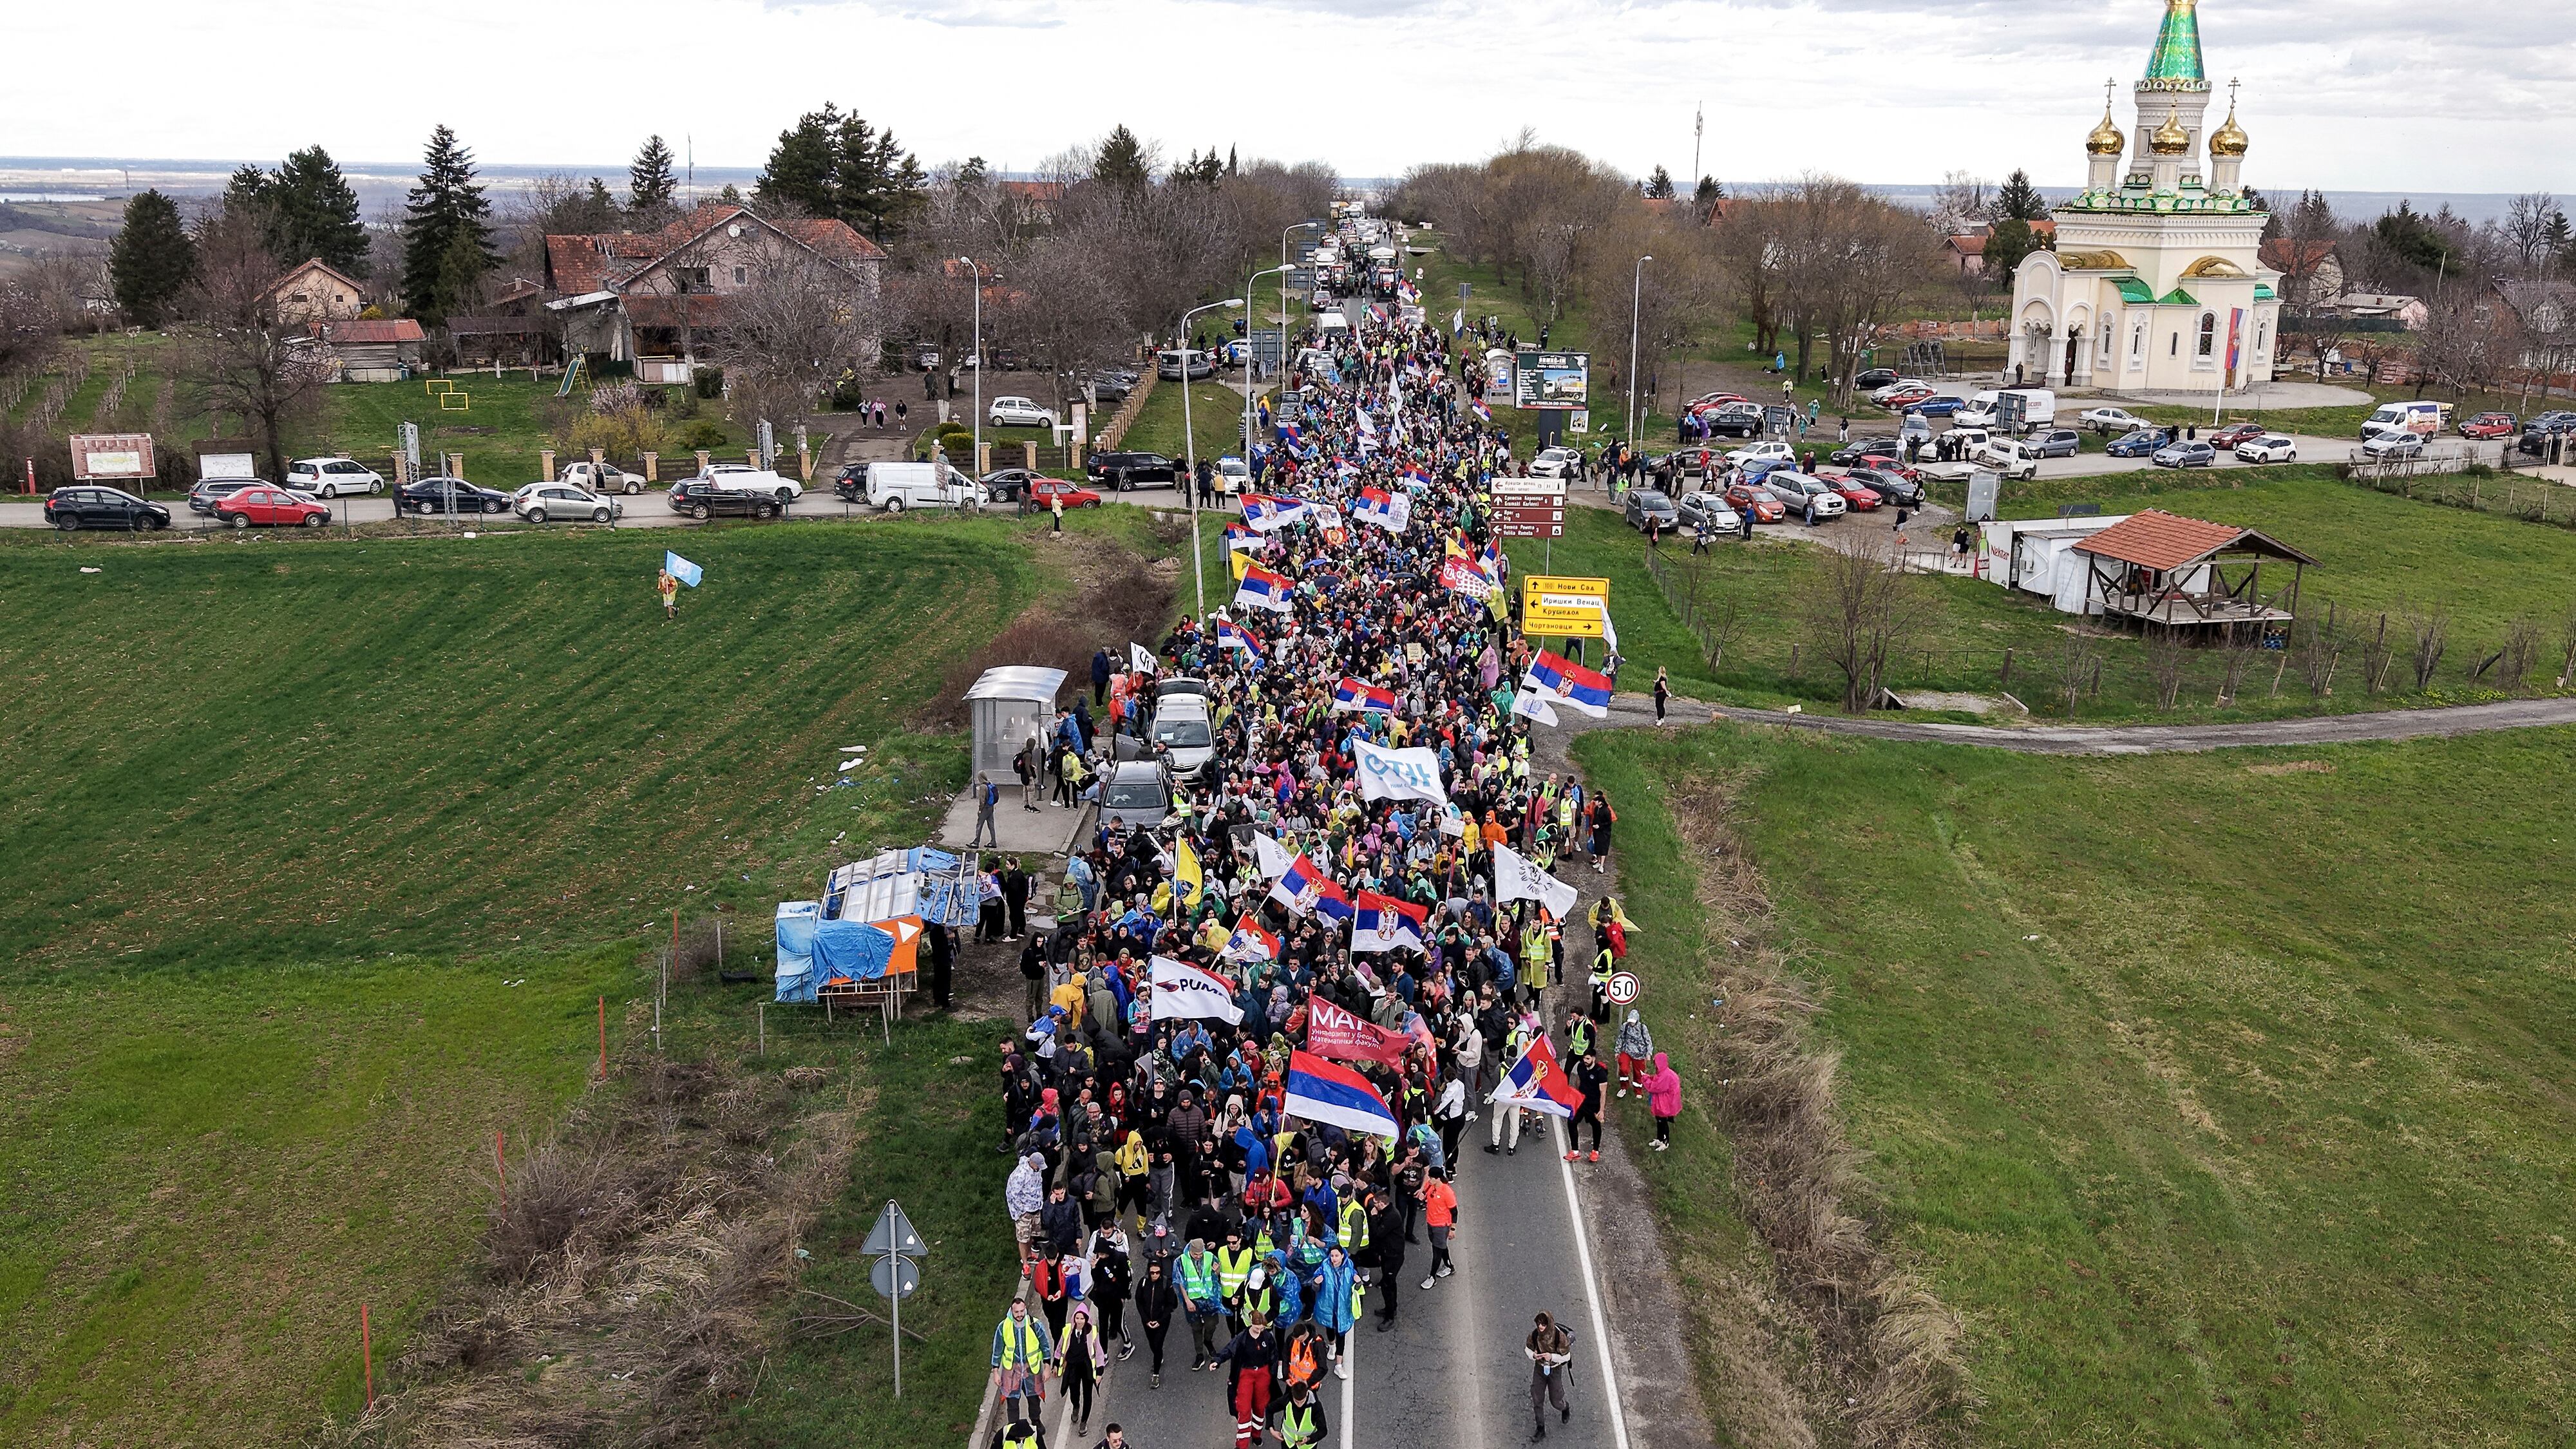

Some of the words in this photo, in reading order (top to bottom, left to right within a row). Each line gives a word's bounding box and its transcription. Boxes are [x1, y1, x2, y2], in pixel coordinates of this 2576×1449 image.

[1991, 544, 2009, 560] Nektar
[1543, 608, 1579, 616] Крушедол
[1529, 621, 1573, 630] Чортановци
[1613, 981, 1633, 996] 50
[1311, 1029, 1350, 1037] Универзитет
[1311, 1036, 1353, 1045] Математички
